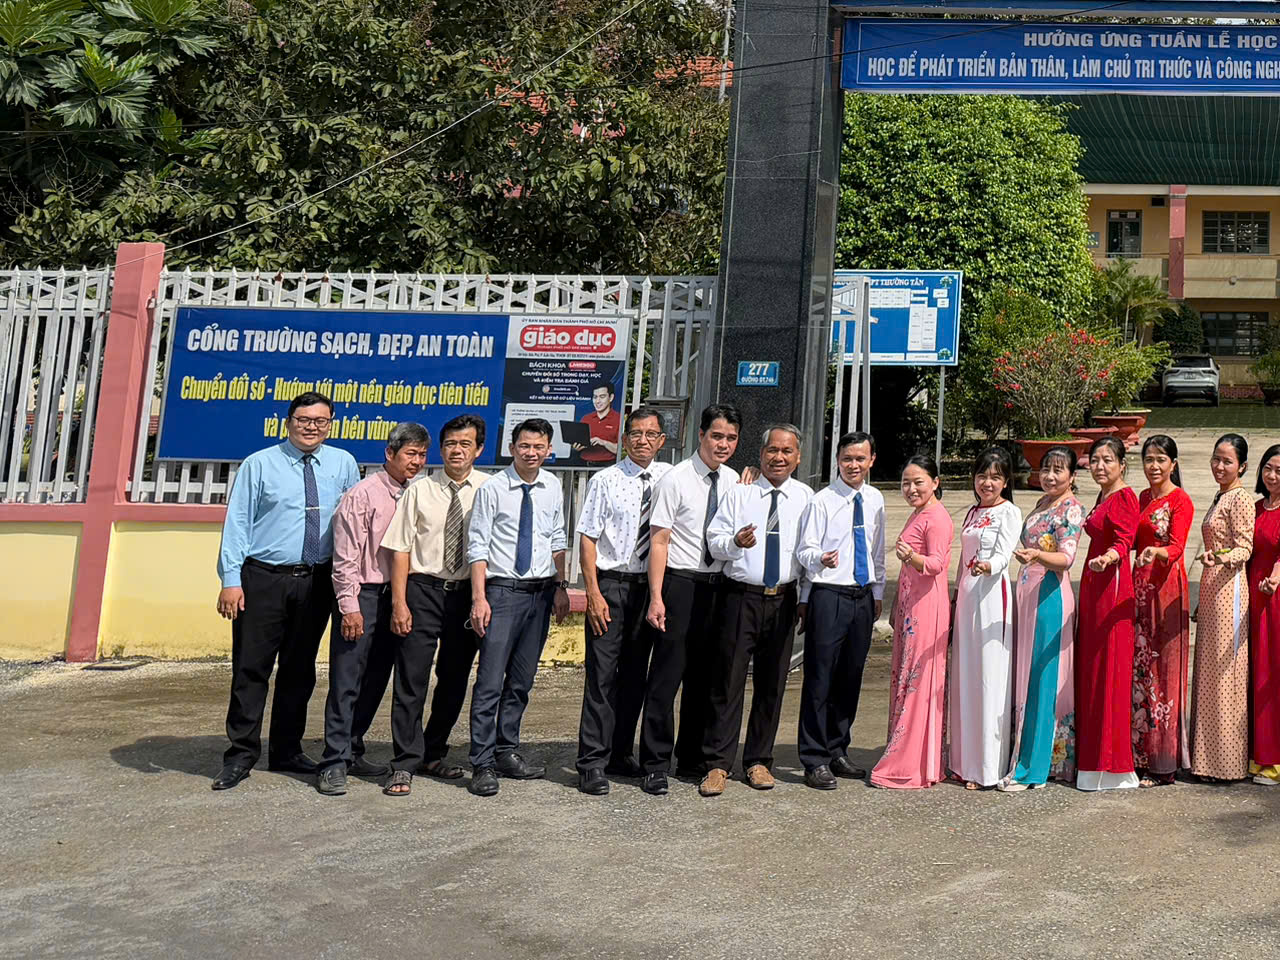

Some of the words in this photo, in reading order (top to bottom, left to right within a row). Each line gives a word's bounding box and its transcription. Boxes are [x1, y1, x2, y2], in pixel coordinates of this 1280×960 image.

[1023, 29, 1094, 47] HƯỞNG
[1100, 30, 1142, 48] ỨNG
[1149, 30, 1201, 48] TUẦN
[1208, 30, 1230, 49] LỄ
[1237, 35, 1277, 52] HỌC
[868, 57, 895, 81] HỌC
[898, 50, 917, 77] ĐỂ
[919, 53, 954, 77] PHÁT
[957, 50, 995, 77] TRIỂN
[1000, 51, 1026, 78] BẢN
[1031, 54, 1069, 80] THÂN,
[1073, 54, 1100, 78] LÀM
[1105, 53, 1131, 78] CHỦ
[1135, 59, 1155, 78] TRI
[1159, 55, 1192, 79] THỨC
[1196, 55, 1212, 79] VÀ
[1216, 56, 1252, 79] CÔNG
[187, 322, 240, 352] CỔNG
[243, 326, 317, 354] TRƯỜNG
[320, 331, 373, 359] SẠCH,
[377, 333, 413, 361] ĐẸP,
[416, 334, 442, 357] AN
[446, 331, 494, 358] TOÀN
[523, 326, 570, 348] giáo
[574, 329, 613, 350] dục
[748, 363, 769, 376] 277
[180, 372, 228, 402] Chuyển
[228, 372, 249, 400] đổi
[250, 375, 268, 401] số
[333, 379, 358, 408] một
[359, 378, 384, 404] nền
[384, 380, 412, 407] giáo
[414, 381, 437, 410] dục
[439, 381, 464, 406] tiên
[464, 380, 490, 406] tiến
[264, 413, 278, 438] và
[341, 414, 366, 439] bền
